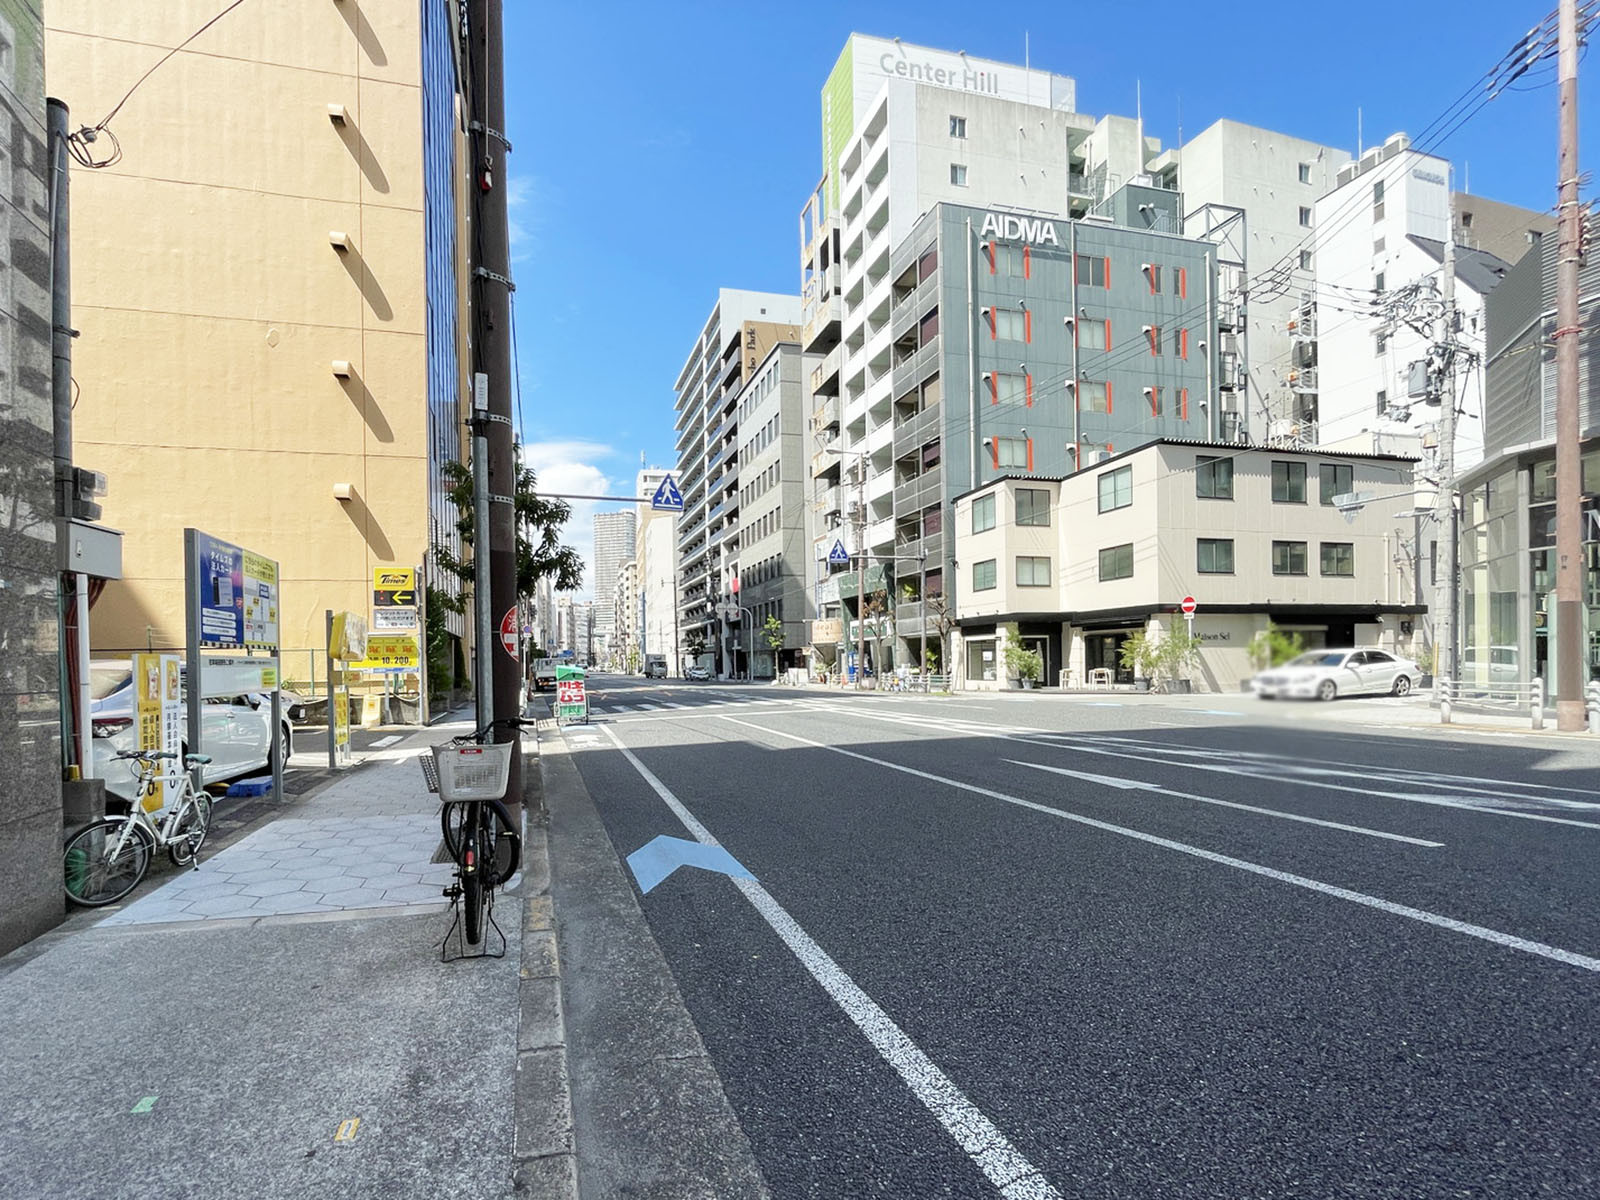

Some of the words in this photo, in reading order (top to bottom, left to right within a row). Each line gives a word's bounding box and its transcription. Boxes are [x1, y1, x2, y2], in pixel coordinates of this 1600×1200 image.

[880, 53, 956, 85] Center
[963, 69, 998, 94] Hill
[980, 213, 1059, 247] AIDMA
[746, 328, 756, 350] Park
[380, 574, 409, 584] Times
